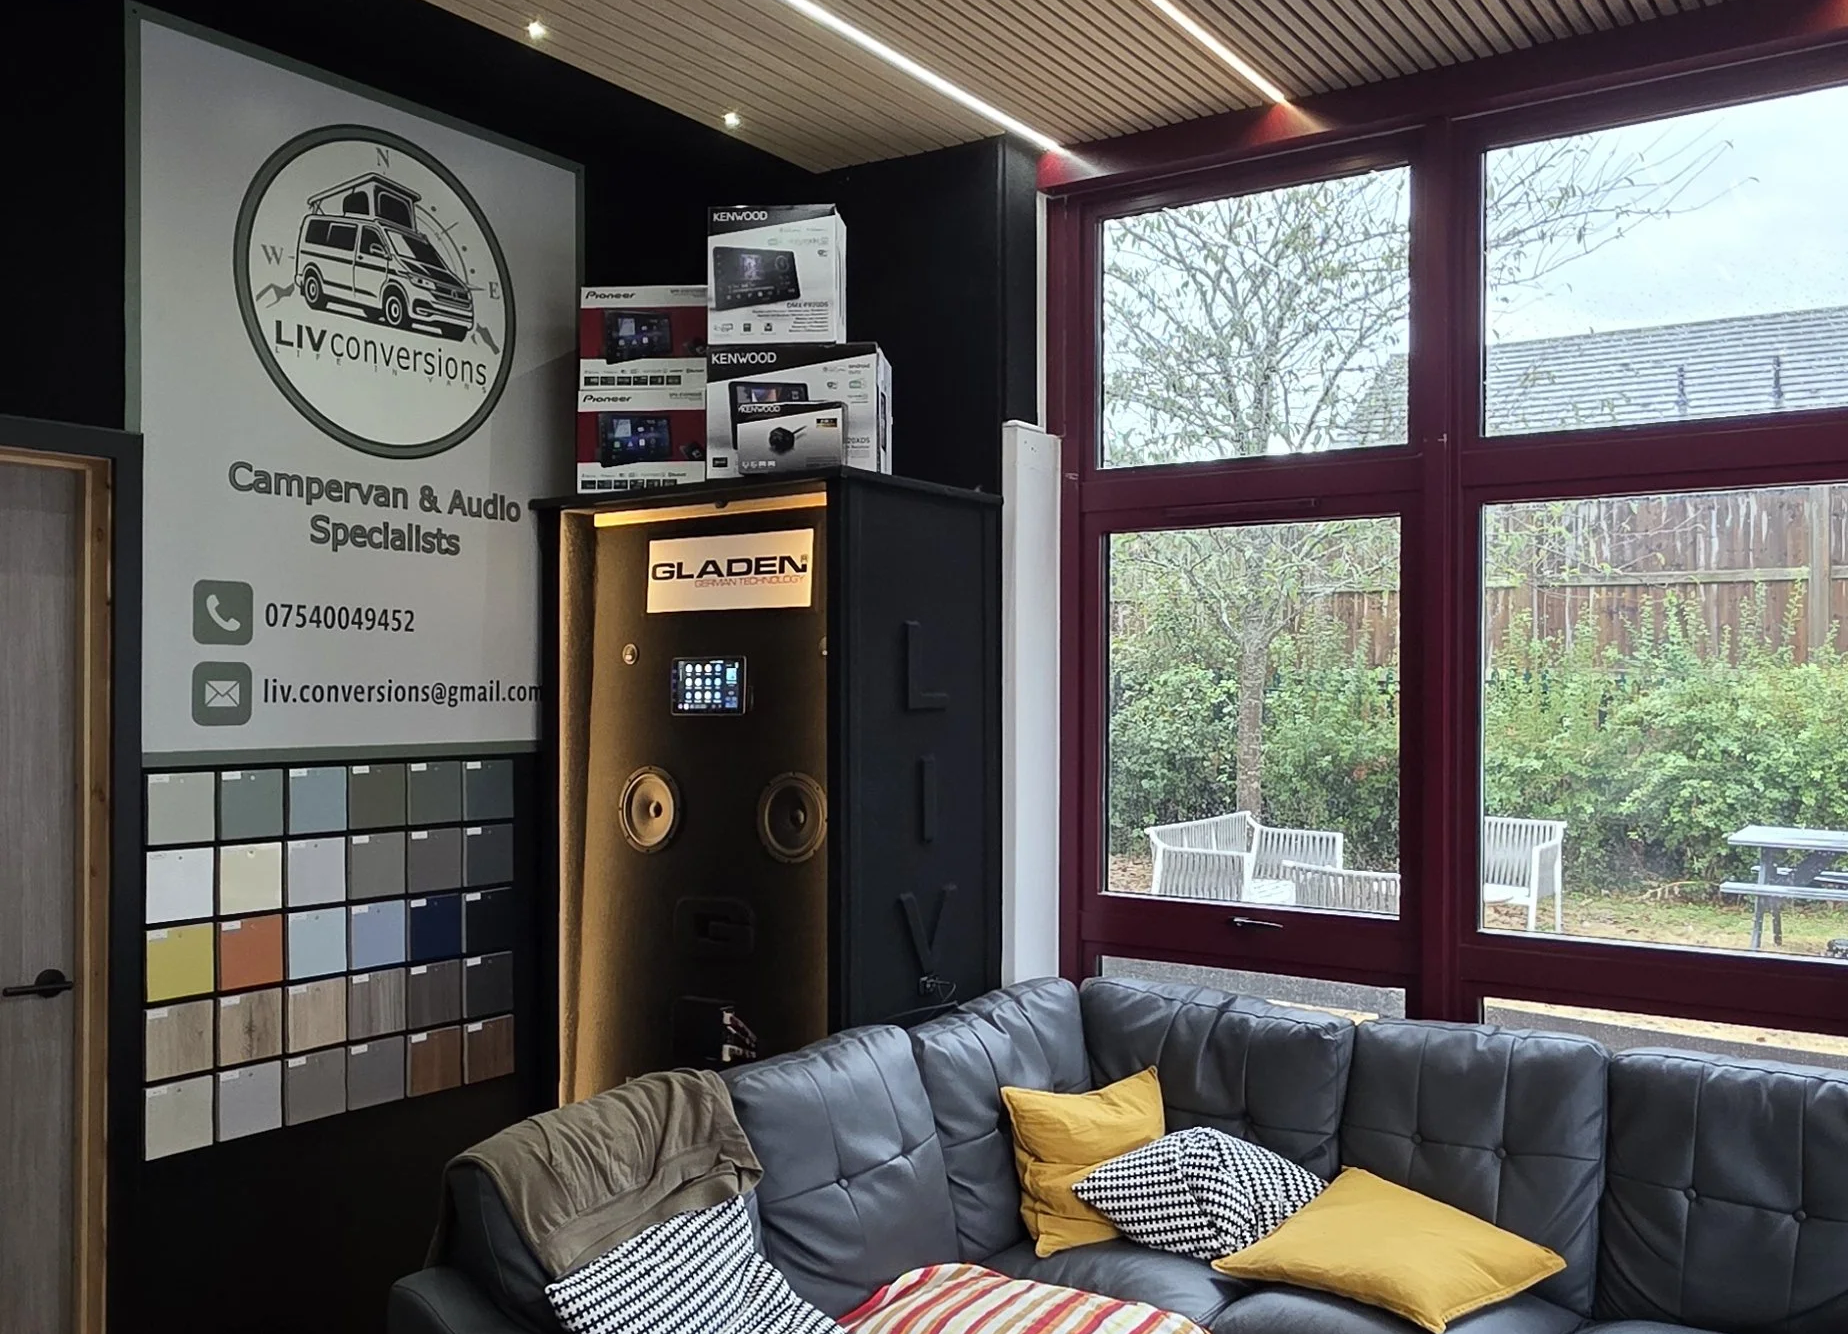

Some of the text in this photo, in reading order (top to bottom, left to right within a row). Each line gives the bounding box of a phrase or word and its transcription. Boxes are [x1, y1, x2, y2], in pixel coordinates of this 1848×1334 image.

[375, 147, 390, 168] N
[712, 210, 769, 222] KENWOOD
[261, 244, 284, 266] W
[487, 281, 501, 300] E
[585, 290, 636, 300] Pioneer
[711, 351, 777, 365] KENWOOD
[583, 394, 632, 403] Pioneer
[741, 405, 781, 414] KENWOOD
[228, 460, 522, 523] Campervan & Audio
[309, 514, 461, 557] Specialists
[651, 554, 808, 582] GLADEN
[694, 574, 806, 589] GERMAN TECHNOLOGY
[265, 603, 415, 632] 07540049452
